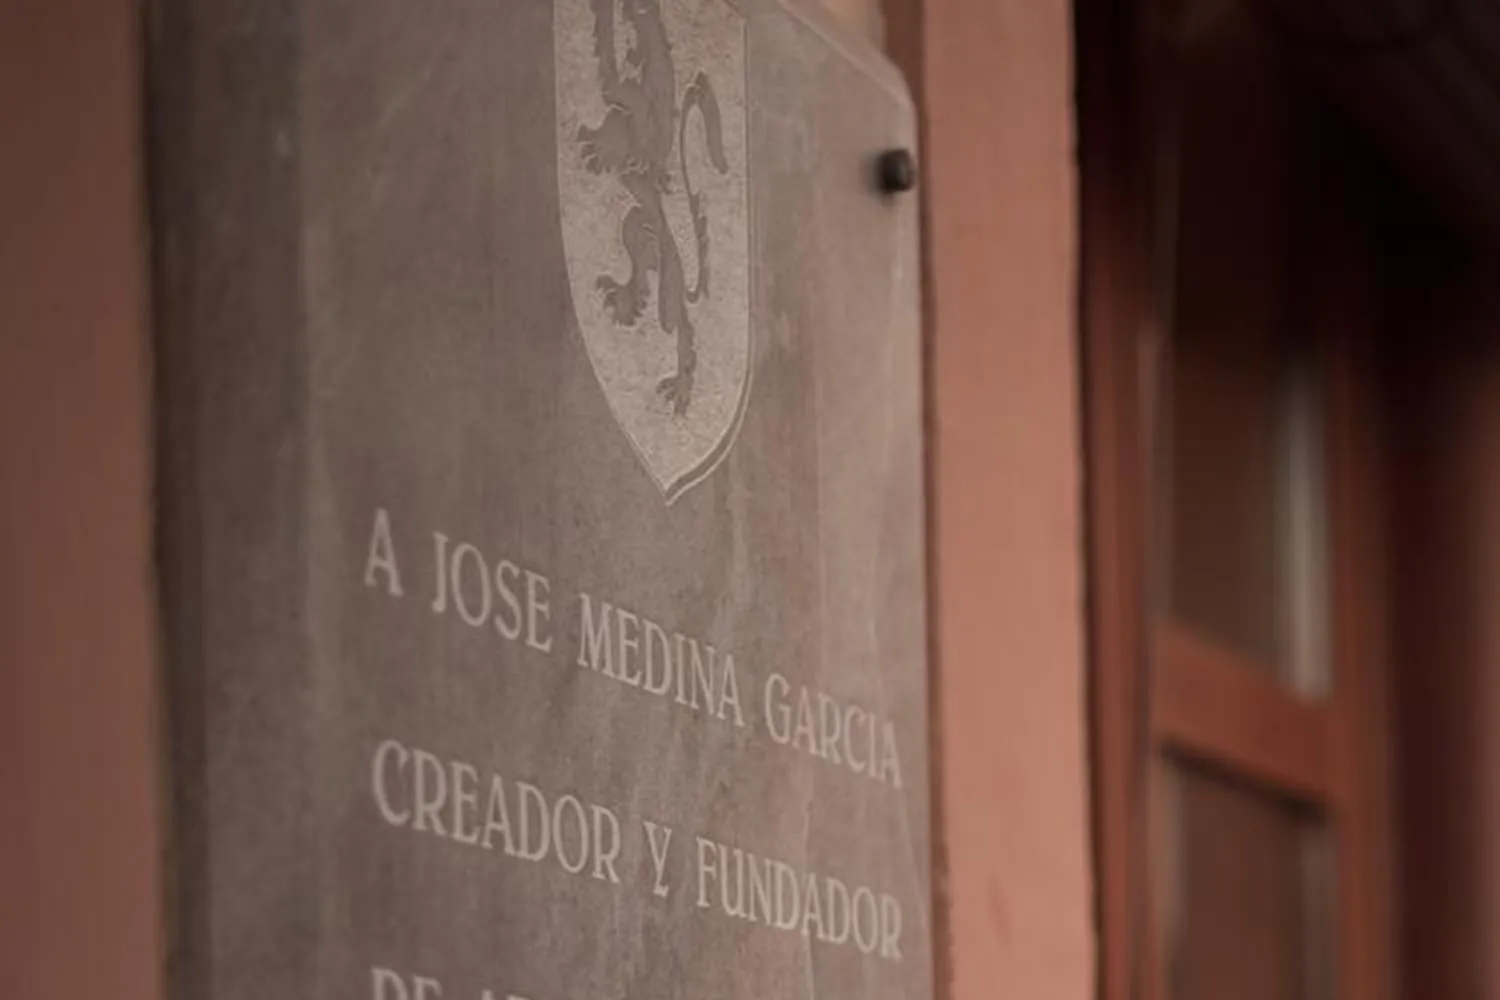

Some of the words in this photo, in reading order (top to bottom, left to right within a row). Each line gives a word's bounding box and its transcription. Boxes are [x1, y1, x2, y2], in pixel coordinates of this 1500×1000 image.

[364, 507, 403, 596] A
[432, 531, 552, 653] JOSE
[577, 593, 744, 727] MEDINA
[763, 672, 902, 789] GARCIA
[371, 739, 620, 884] CREADOR
[643, 820, 672, 897] Y
[695, 836, 902, 960] FUNDADOR
